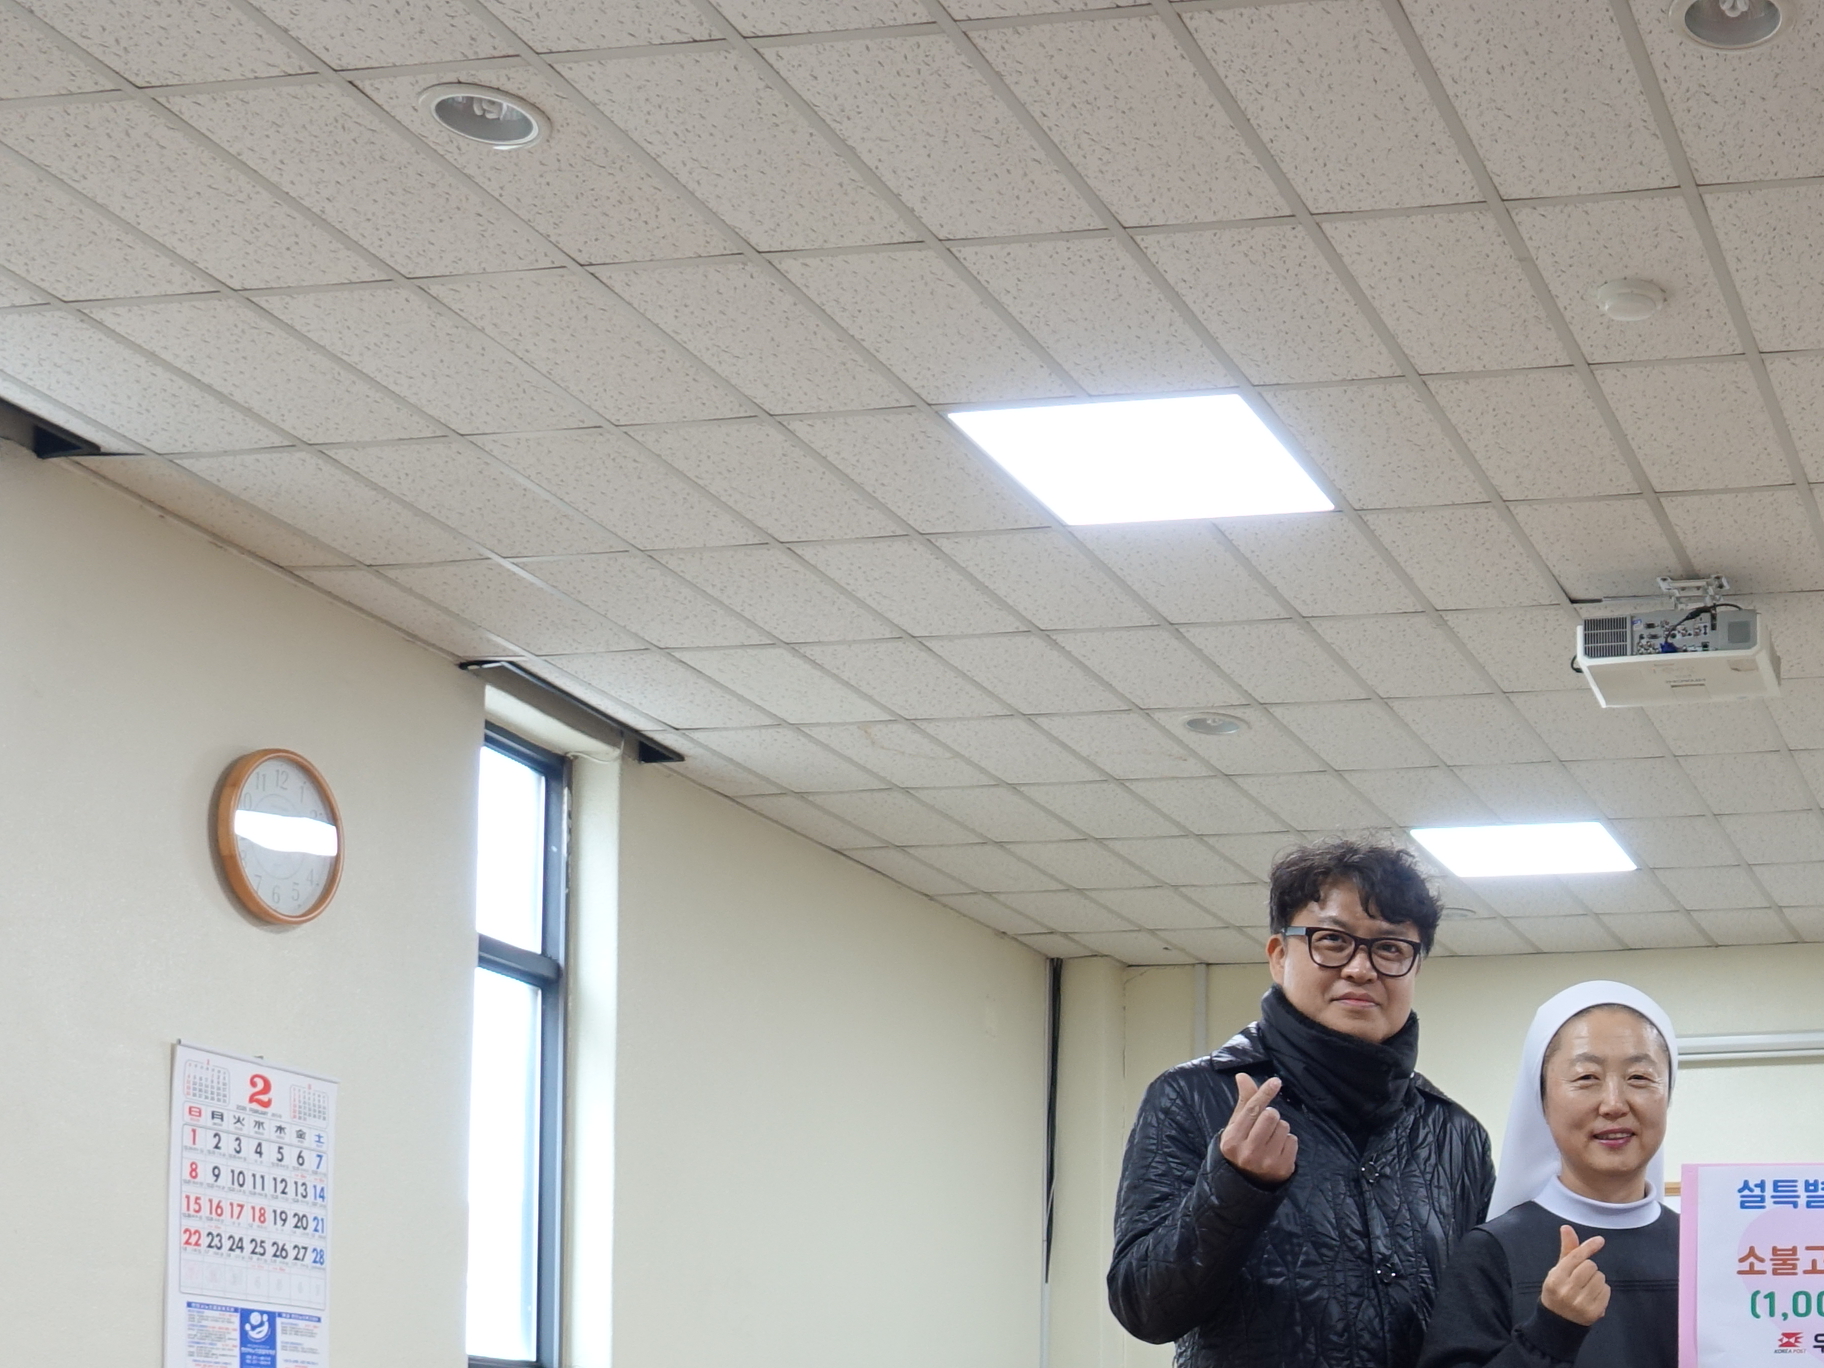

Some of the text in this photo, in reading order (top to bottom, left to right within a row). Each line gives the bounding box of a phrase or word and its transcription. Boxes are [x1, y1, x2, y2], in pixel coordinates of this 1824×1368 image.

[248, 1073, 273, 1109] 2
[188, 1106, 325, 1145] 日 月 火 水 木 金 土
[190, 1128, 324, 1170] 1 2 3 4 5 6 7
[189, 1161, 325, 1202] 8 9 10 11 12 13 14
[184, 1194, 325, 1234] 15 16 17 18 19 20 21
[183, 1227, 325, 1266] 22 23 24 25 26 27 28
